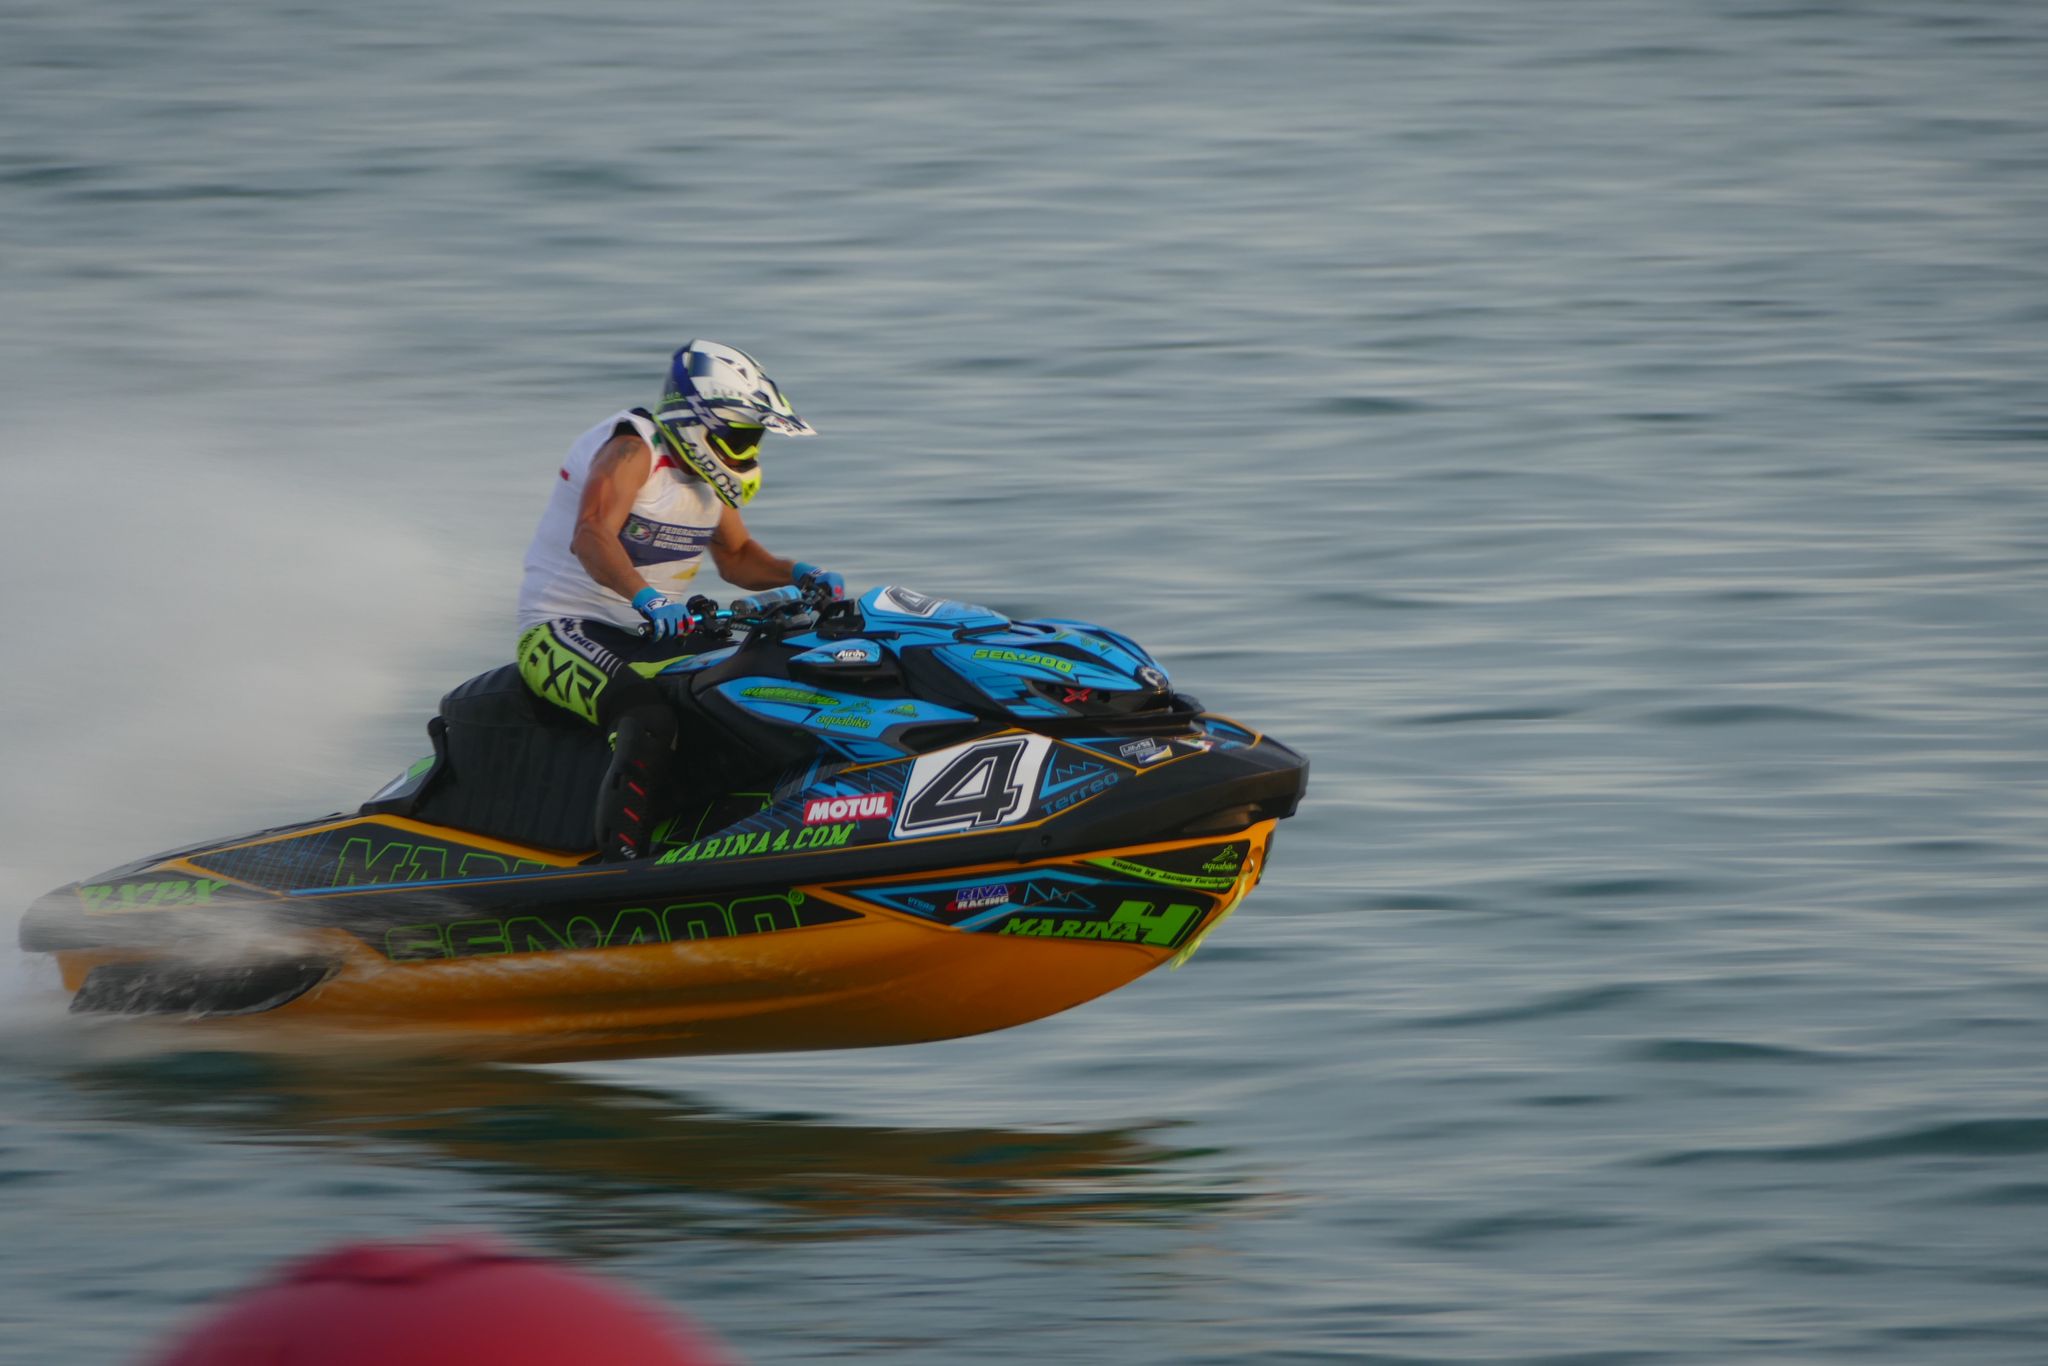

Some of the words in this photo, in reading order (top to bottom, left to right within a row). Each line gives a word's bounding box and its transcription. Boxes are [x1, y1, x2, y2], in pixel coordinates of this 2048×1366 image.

[900, 737, 1026, 833] 4
[807, 796, 888, 822] MOTUL
[957, 884, 1008, 902] RIVA
[957, 895, 1009, 910] RACING
[1000, 918, 1139, 941] MARINA
